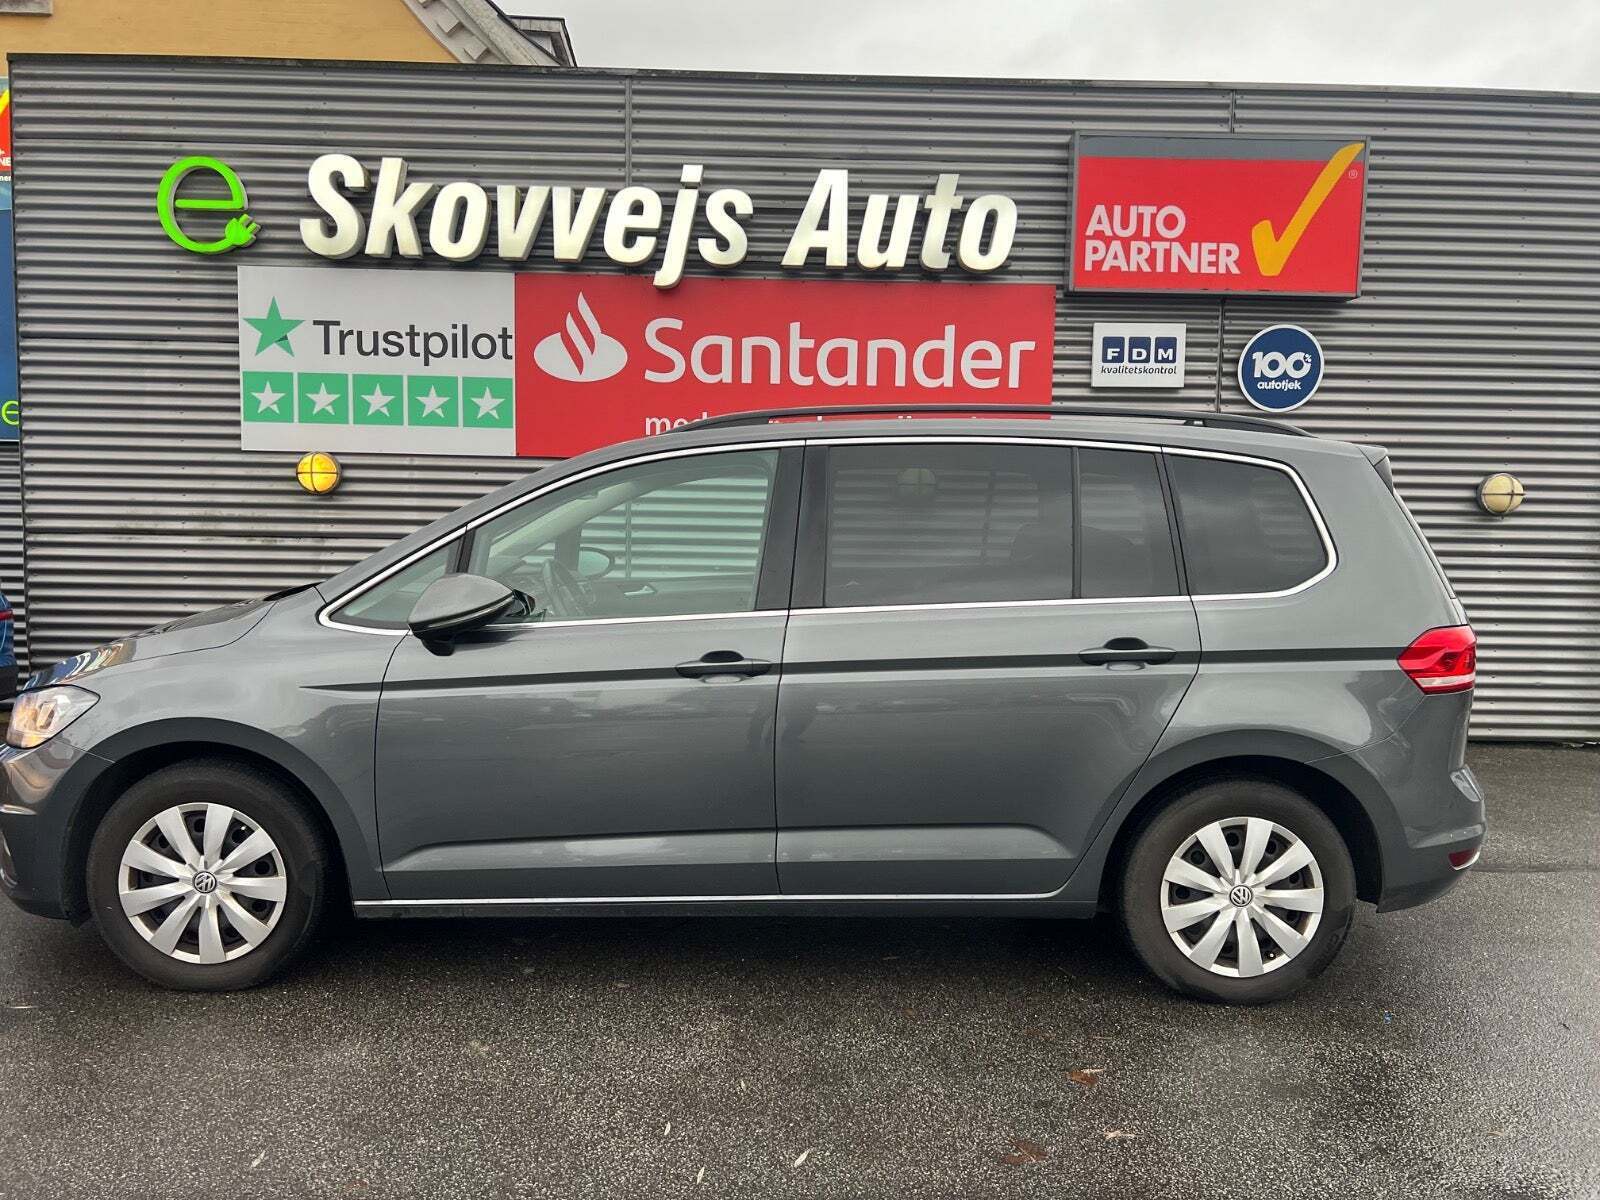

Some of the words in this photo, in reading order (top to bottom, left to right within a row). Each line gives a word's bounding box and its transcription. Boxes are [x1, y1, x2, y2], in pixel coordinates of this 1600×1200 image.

[299, 153, 754, 289] Skovvejs
[780, 169, 1018, 272] Auto
[1085, 204, 1187, 239] AUTO
[1084, 239, 1241, 276] PARTNER
[312, 319, 513, 367] Trustpilot
[644, 316, 1036, 390] Santander
[1106, 348, 1174, 361] FDM
[1100, 365, 1177, 375] kvalitetskontrol
[1257, 380, 1302, 391] autotjek
